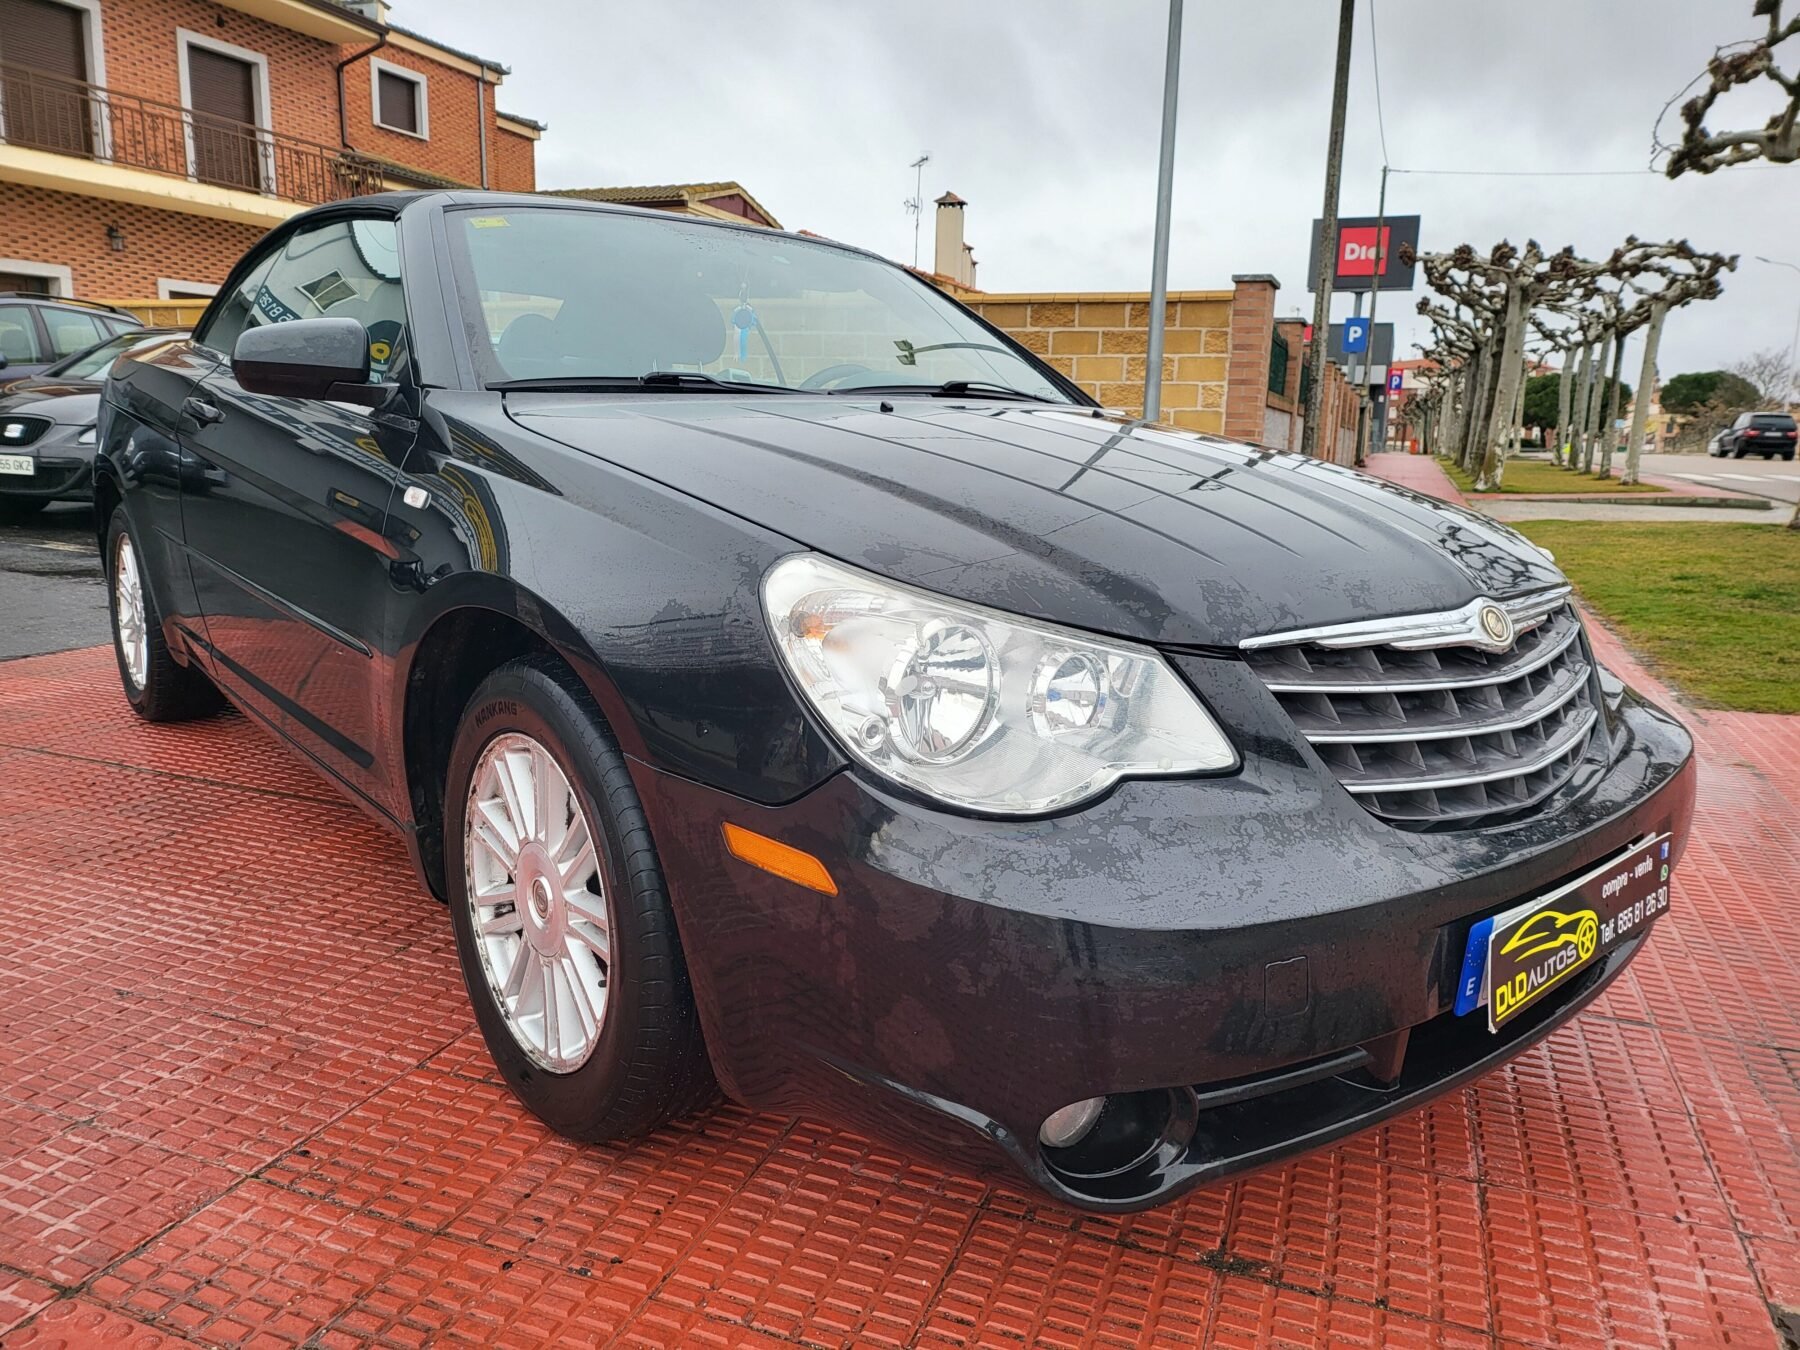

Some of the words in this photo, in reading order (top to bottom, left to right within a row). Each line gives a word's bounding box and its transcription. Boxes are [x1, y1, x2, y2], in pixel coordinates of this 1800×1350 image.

[1348, 326, 1363, 343] P
[1391, 375, 1400, 389] P
[13, 460, 31, 471] GKZ
[1602, 872, 1628, 899] compra
[1634, 854, 1653, 879] venta
[1617, 906, 1633, 934] 655
[1634, 900, 1644, 923] 81
[1645, 892, 1656, 916] 26
[1657, 886, 1668, 909] 30
[1465, 977, 1476, 997] E
